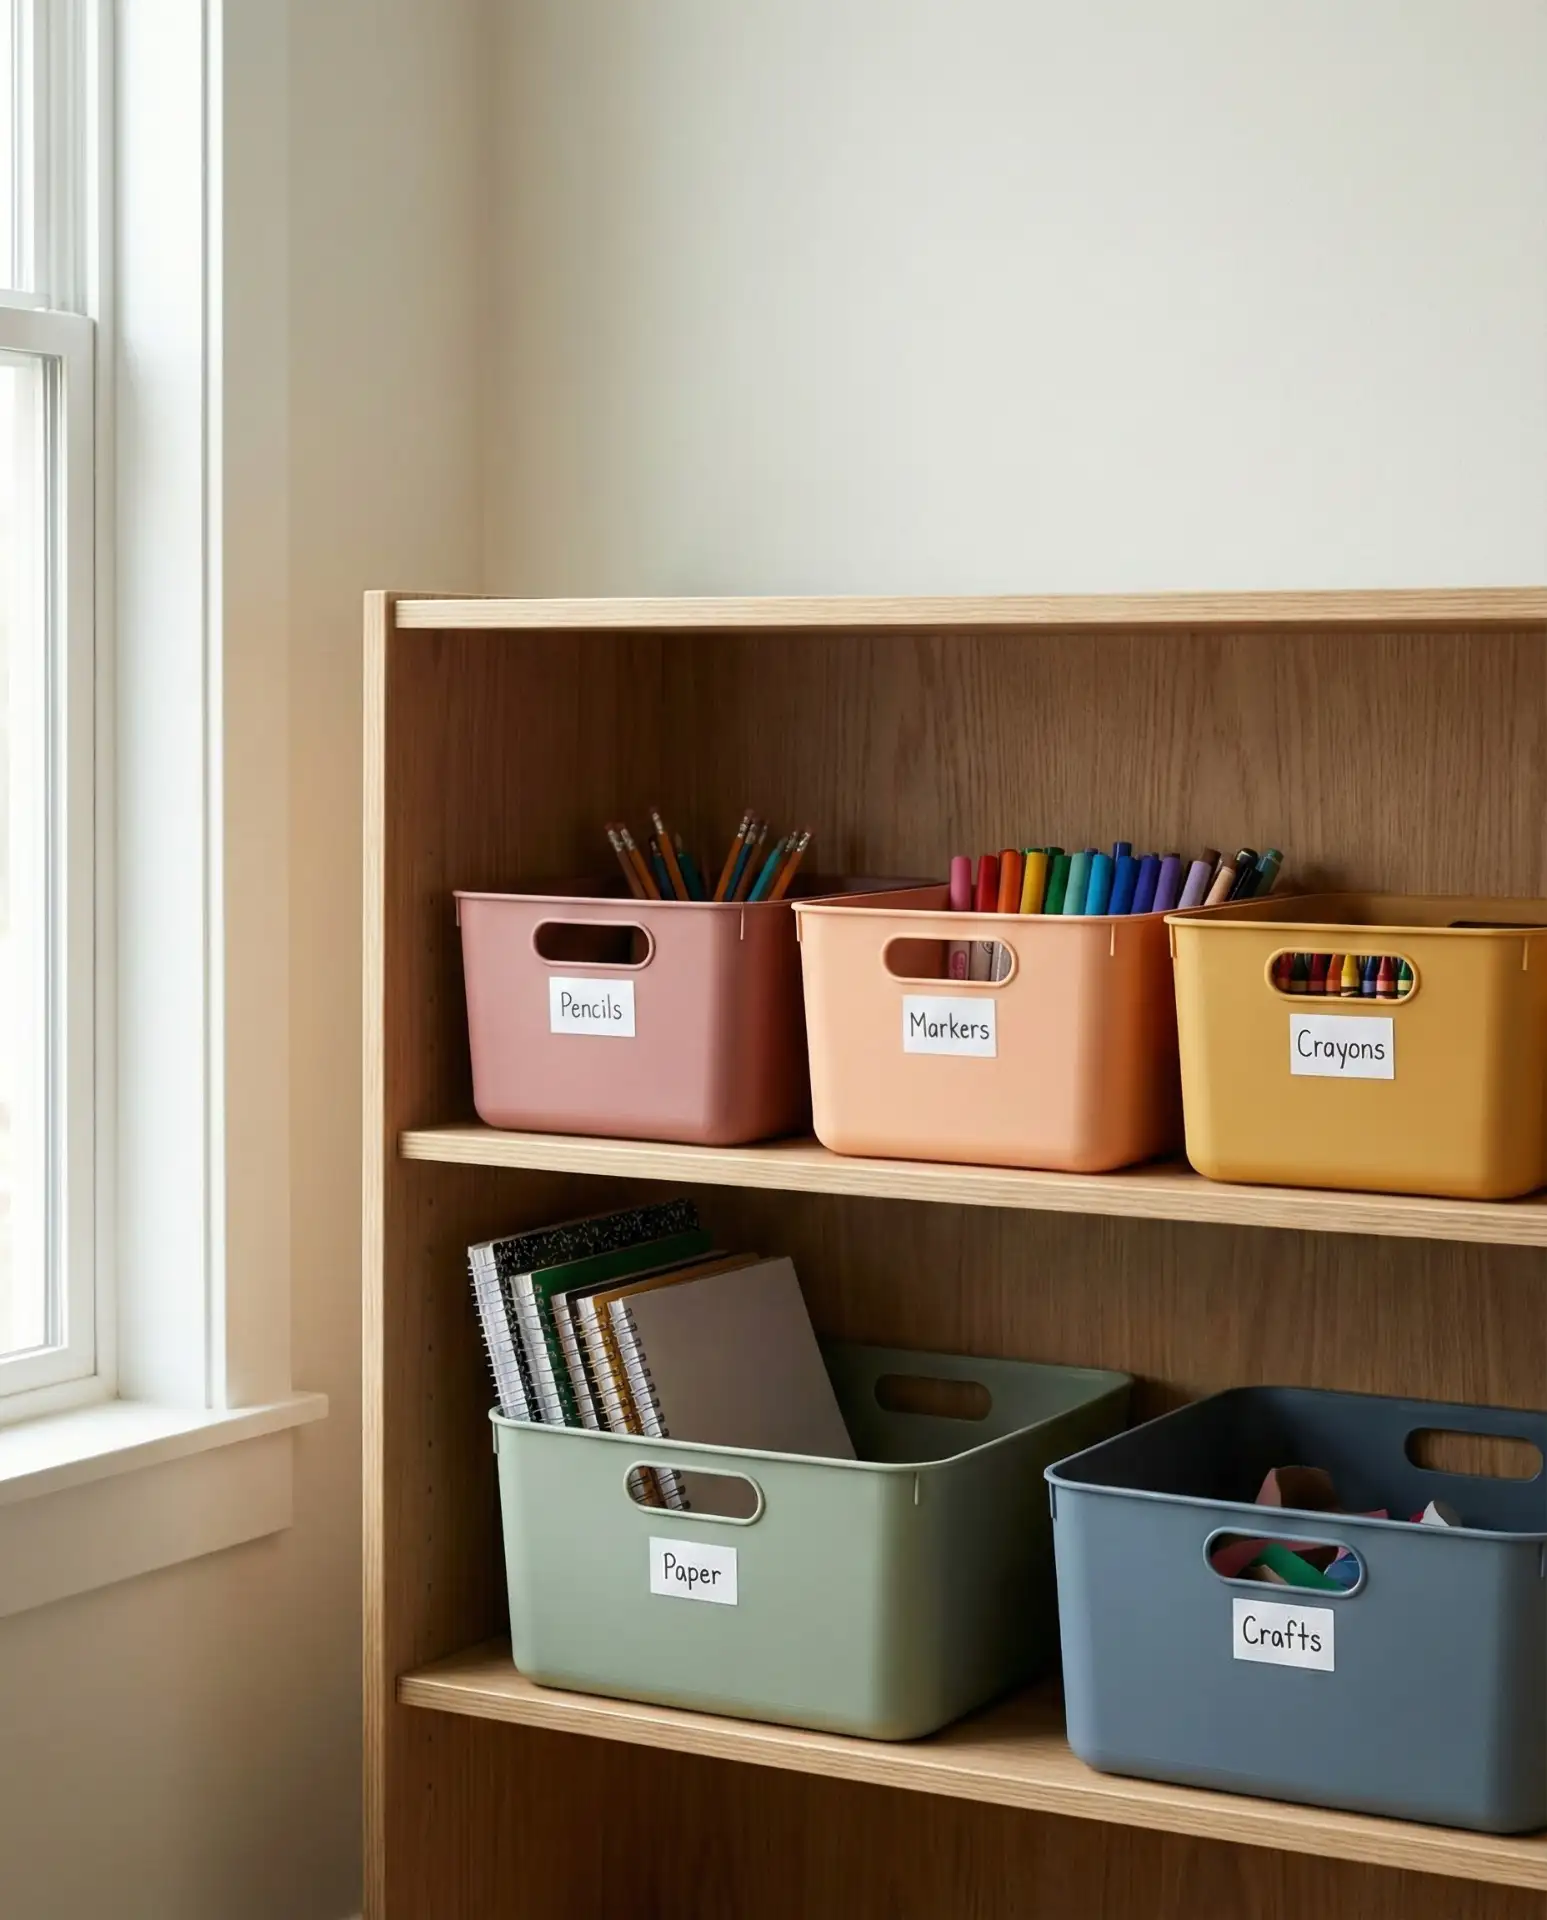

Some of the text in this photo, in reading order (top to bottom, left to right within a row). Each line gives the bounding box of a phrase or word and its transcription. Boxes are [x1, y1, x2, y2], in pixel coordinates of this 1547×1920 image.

[561, 992, 622, 1020] Pencils
[910, 1012, 990, 1040] Markers
[1297, 1029, 1386, 1069] Crayons
[664, 1552, 722, 1591] Paper
[1242, 1615, 1322, 1652] Crafts
